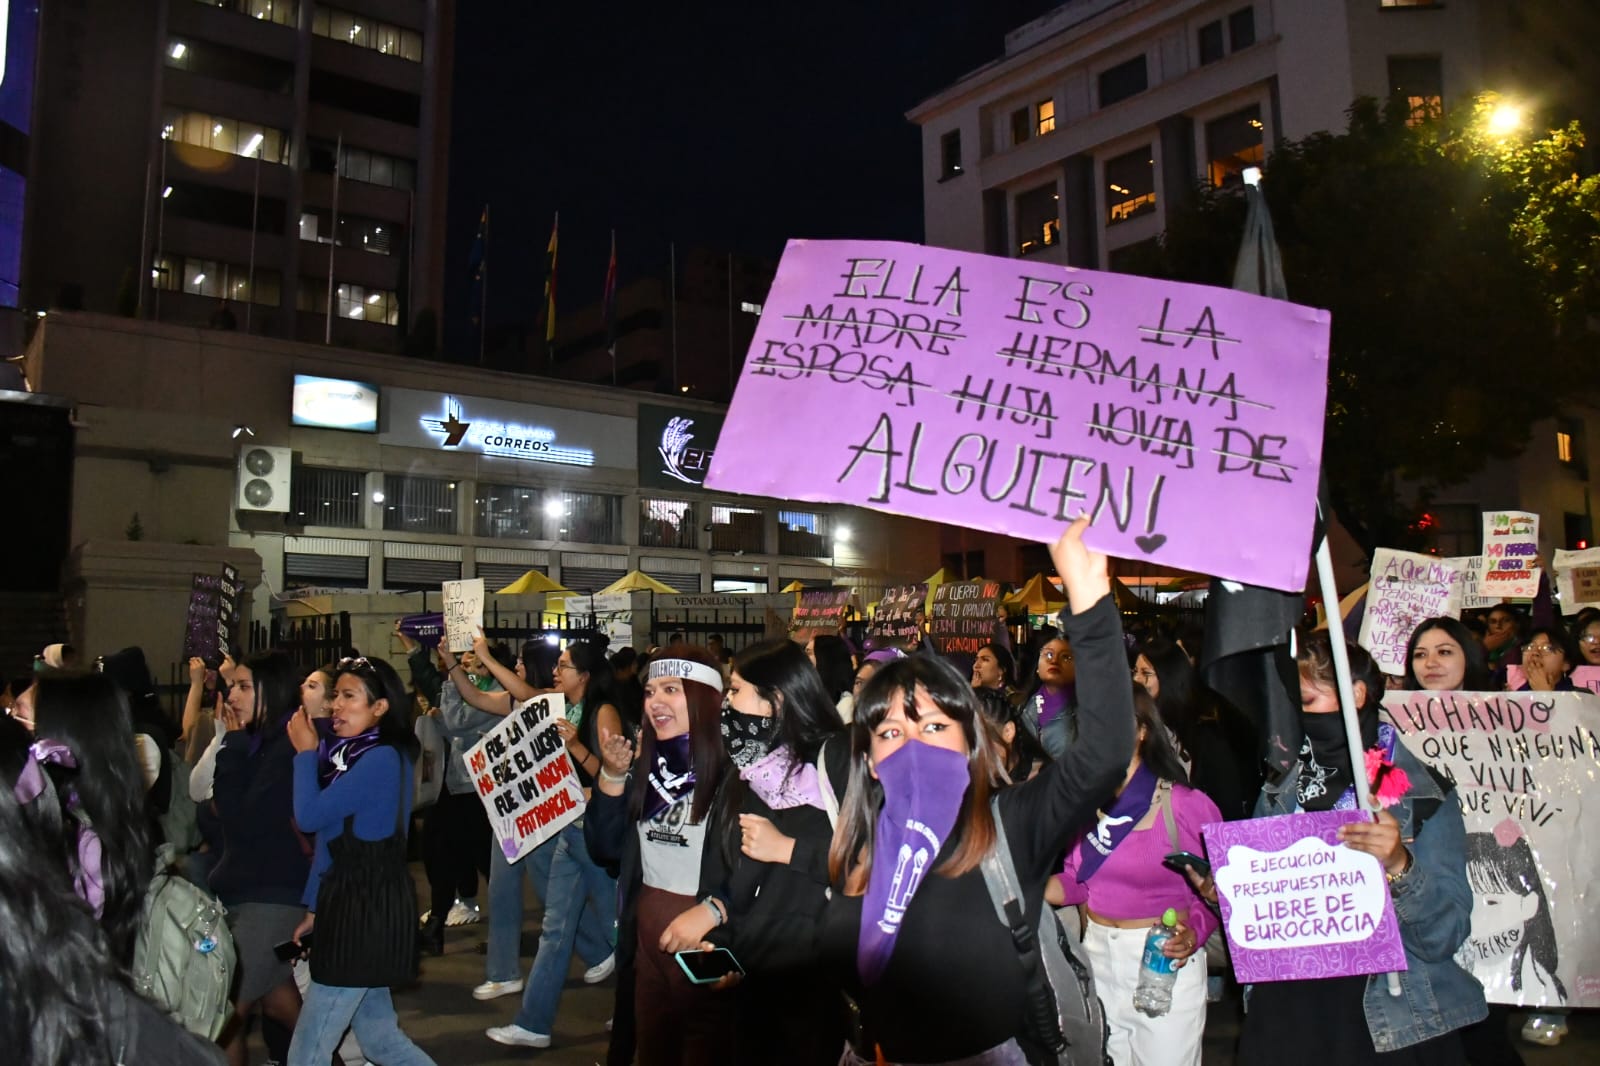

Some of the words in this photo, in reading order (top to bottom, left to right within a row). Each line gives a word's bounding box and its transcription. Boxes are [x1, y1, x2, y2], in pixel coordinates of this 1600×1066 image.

[833, 258, 970, 316] ELLA
[1004, 276, 1093, 329] ES
[1138, 298, 1240, 360] LA
[785, 303, 966, 356] MADRE
[997, 332, 1262, 420] HERMANA
[751, 340, 928, 406] ESPOSA
[948, 374, 1058, 439] HIJA
[1085, 403, 1198, 468] NOVIA
[1213, 427, 1297, 483] DE
[484, 435, 550, 452] CORREOS
[837, 412, 1167, 553] ALGUIEN!
[1487, 543, 1504, 557] YO
[950, 585, 979, 600] CUERPO
[983, 583, 1000, 598] NO
[1384, 696, 1555, 735] LUCHANDO
[470, 750, 487, 775] NO
[485, 733, 506, 763] FUE
[506, 720, 525, 746] LA
[520, 698, 550, 732] ROPA
[1422, 735, 1474, 761] QUE
[1488, 726, 1600, 764] NINGUNA
[477, 773, 495, 797] NO
[492, 758, 518, 787] FUE
[513, 750, 533, 773] EL
[1470, 763, 1537, 793] VIVA
[494, 789, 520, 817] FUE
[517, 776, 540, 803] UN
[1250, 848, 1336, 873] EJECUCIÓN
[1232, 870, 1366, 898] PRESUPUESTARIA
[1254, 896, 1319, 921] LIBRE
[1325, 893, 1356, 914] DE
[1244, 912, 1376, 942] BUROCRACIA
